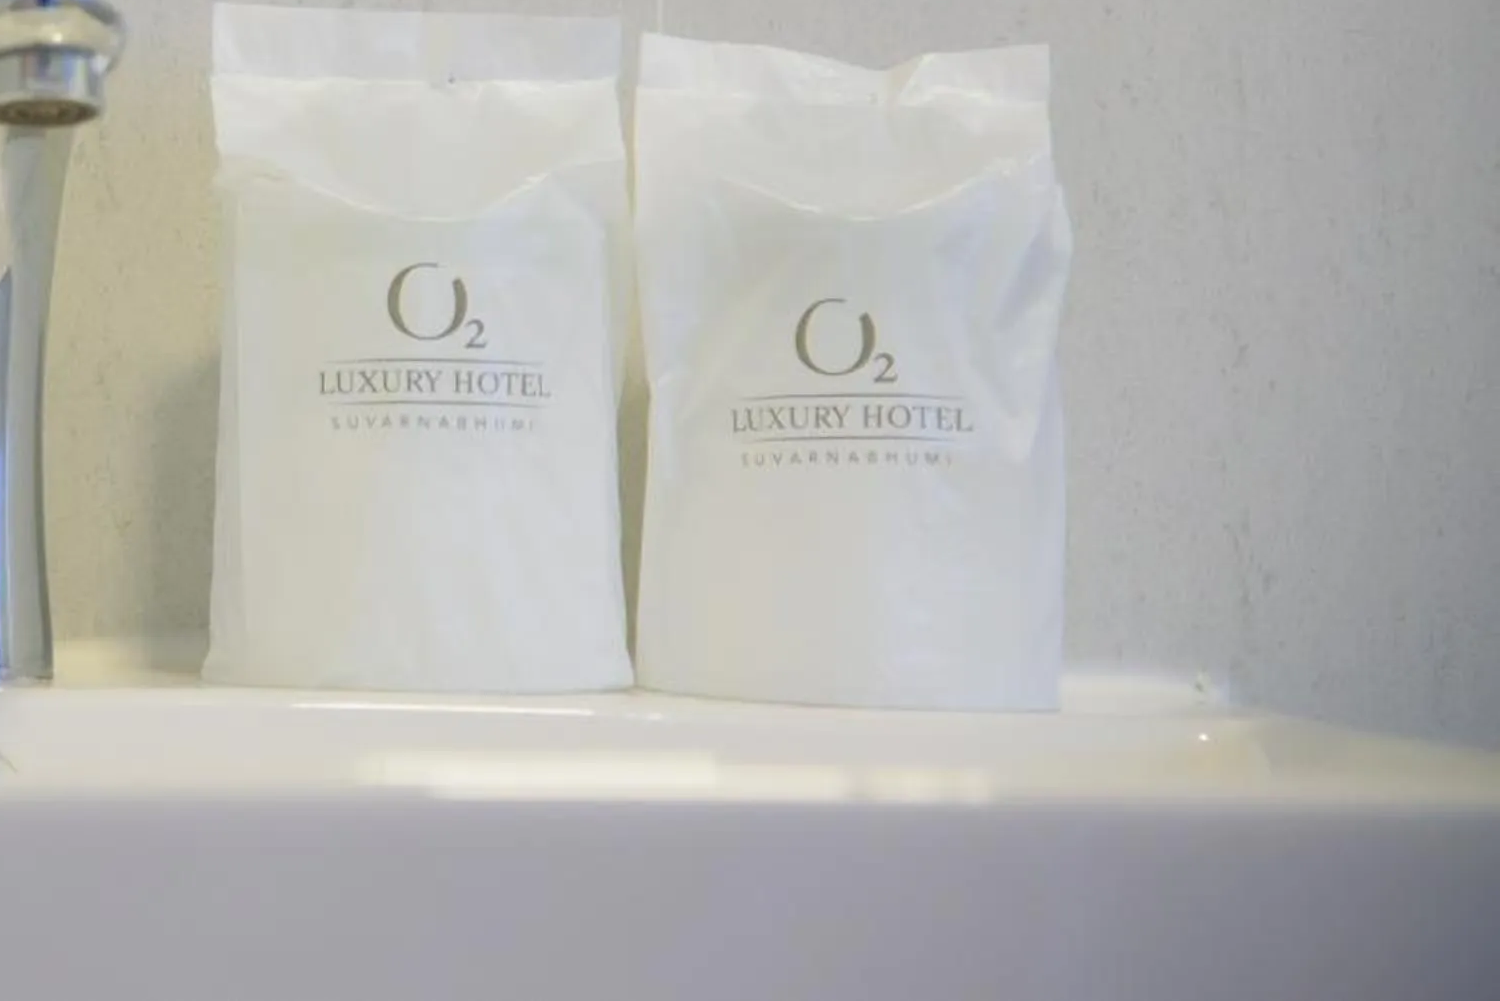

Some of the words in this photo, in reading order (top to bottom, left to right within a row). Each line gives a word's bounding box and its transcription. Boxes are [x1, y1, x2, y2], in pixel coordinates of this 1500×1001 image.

[387, 262, 488, 349] O2
[795, 298, 898, 383] O2
[318, 369, 444, 396] LUXURY
[453, 369, 552, 398] HOTEL
[731, 404, 852, 434] LUXURY
[862, 403, 974, 433] HOTEL
